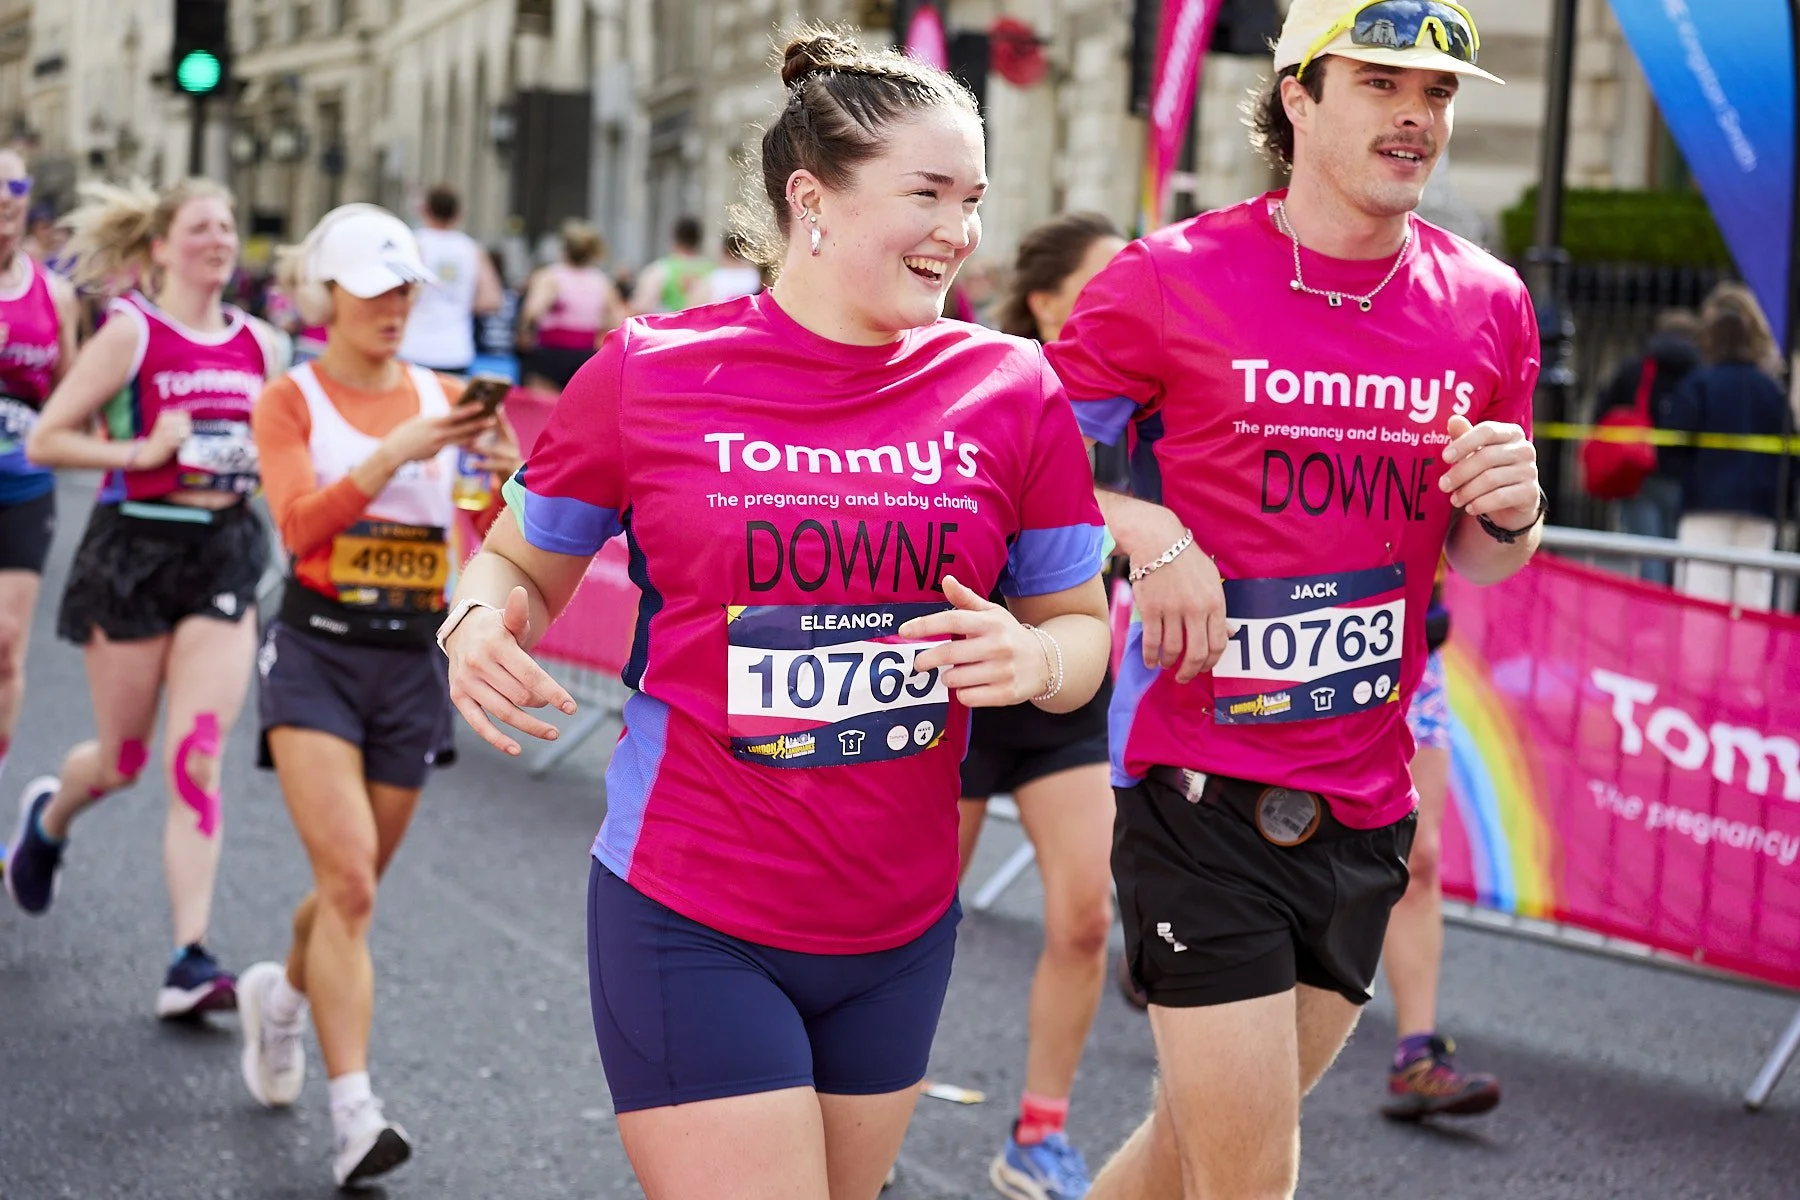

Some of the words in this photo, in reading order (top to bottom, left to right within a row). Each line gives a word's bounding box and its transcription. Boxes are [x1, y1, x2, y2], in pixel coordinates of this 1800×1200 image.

[153, 369, 263, 402] Tommy
[1231, 358, 1475, 424] Tommy's
[1233, 421, 1260, 434] The
[1264, 423, 1344, 442] pregnancy
[1346, 426, 1377, 441] and
[1381, 426, 1419, 447] baby
[1422, 430, 1451, 445] char
[704, 431, 980, 485] Tommy's
[706, 492, 739, 508] The
[744, 493, 840, 509] pregnancy
[844, 492, 879, 507] and
[884, 491, 930, 510] baby
[934, 494, 978, 514] charity
[1261, 449, 1435, 522] DOWNE
[351, 547, 439, 581] 4989
[746, 518, 959, 593] DOWNE
[1290, 581, 1338, 600] JACK
[800, 612, 894, 631] ELEANOR
[1228, 609, 1394, 671] 10763
[748, 647, 940, 709] 10765
[747, 742, 778, 754] LONDON
[848, 738, 854, 750] S
[920, 732, 927, 741] 4
[1590, 667, 1800, 802] Tom
[1587, 779, 1643, 821] The
[1645, 801, 1800, 867] pregnancy
